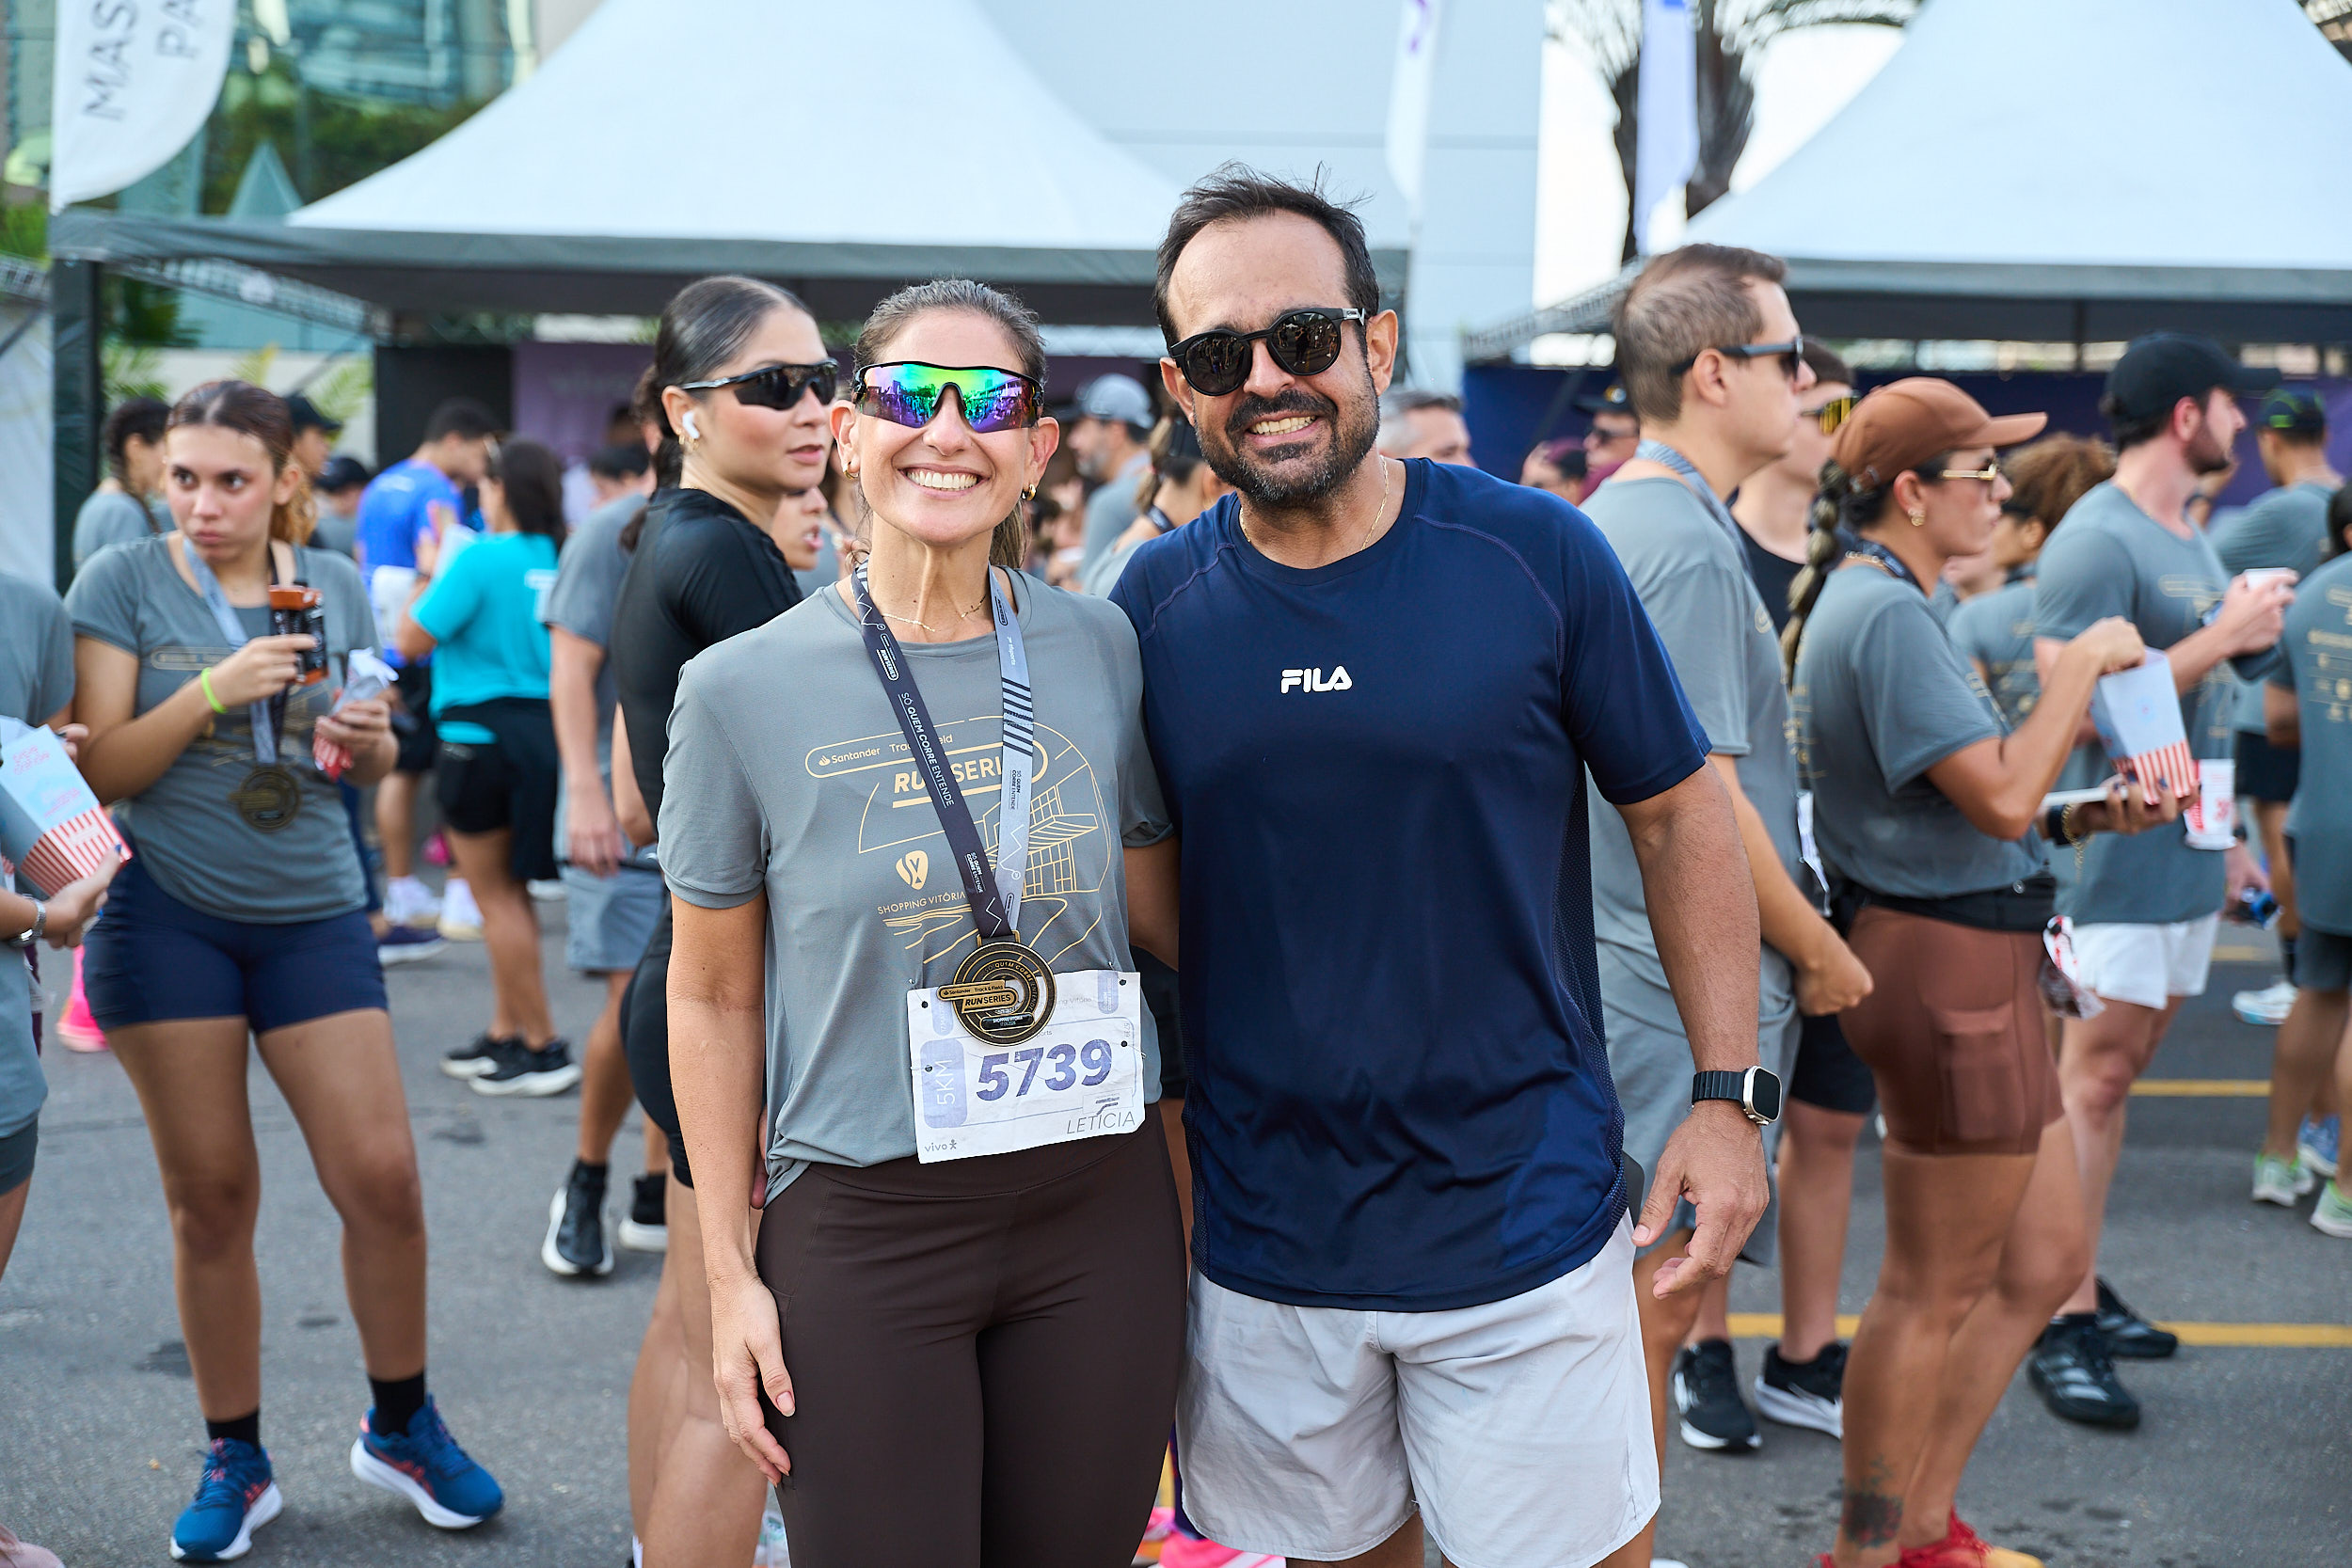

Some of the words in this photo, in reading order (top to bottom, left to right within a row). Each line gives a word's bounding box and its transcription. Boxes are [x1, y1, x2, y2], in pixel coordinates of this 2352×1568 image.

[1280, 665, 1353, 694] FILA
[901, 692, 914, 705] SÓ
[907, 706, 924, 733] QUEM
[831, 747, 881, 764] Santander
[919, 734, 937, 765] CORRE
[931, 765, 955, 806] ENTENDE
[877, 897, 928, 914] SHOPPING
[928, 891, 966, 904] VITÓRIA
[937, 1059, 956, 1105] 5KM
[976, 1038, 1112, 1101] 5739
[924, 1142, 947, 1152] vivo
